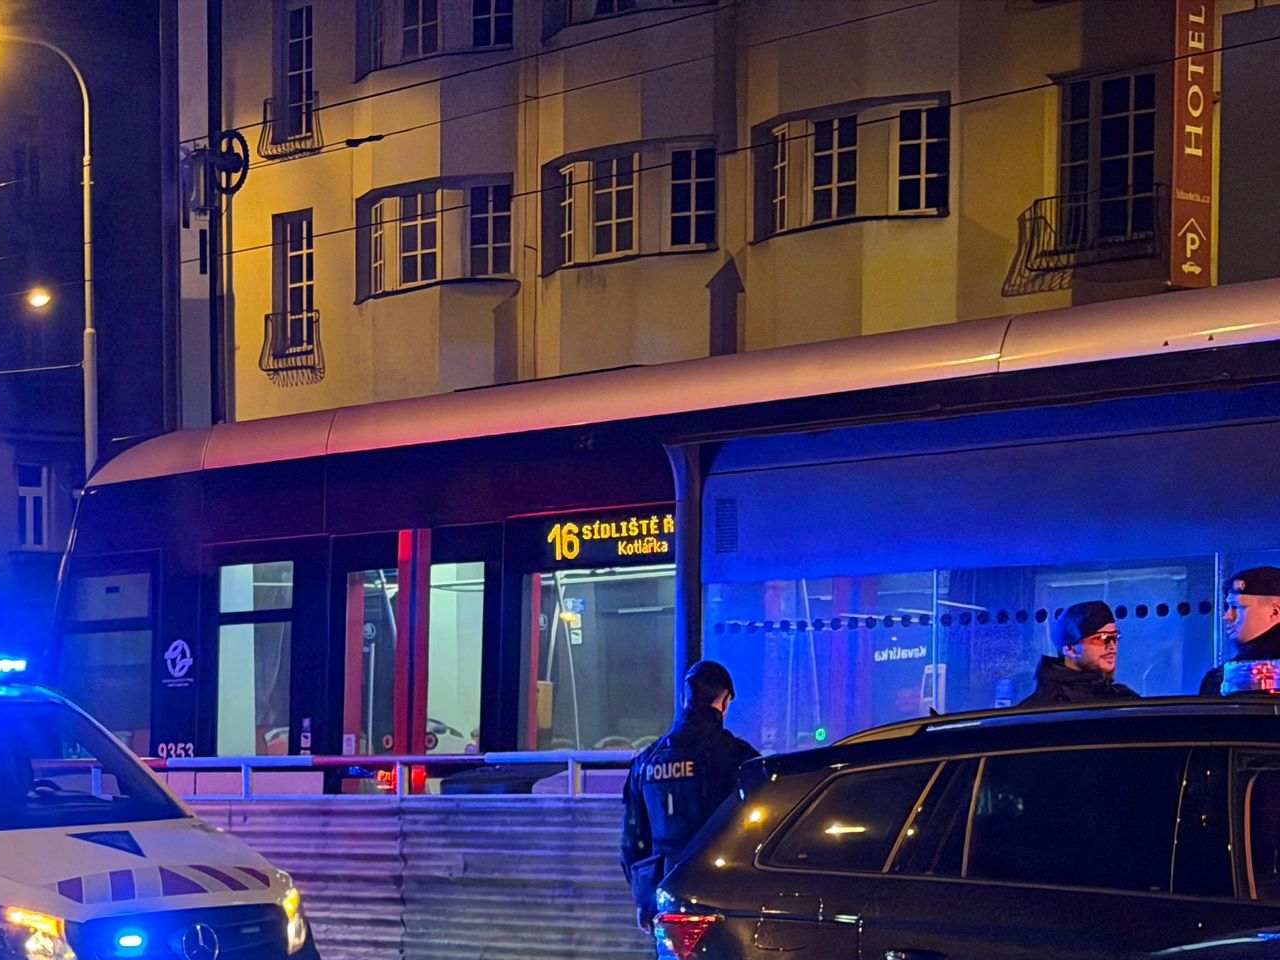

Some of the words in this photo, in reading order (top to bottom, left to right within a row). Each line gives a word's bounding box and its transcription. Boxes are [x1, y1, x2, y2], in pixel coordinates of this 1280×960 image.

[1184, 4, 1206, 157] HOTEL
[1186, 233, 1200, 258] P
[547, 522, 580, 561] 16
[582, 515, 660, 540] SÍDLIŠTĚ
[663, 514, 676, 534] Ř
[158, 742, 194, 758] 9353
[646, 761, 695, 781] POLICIE
